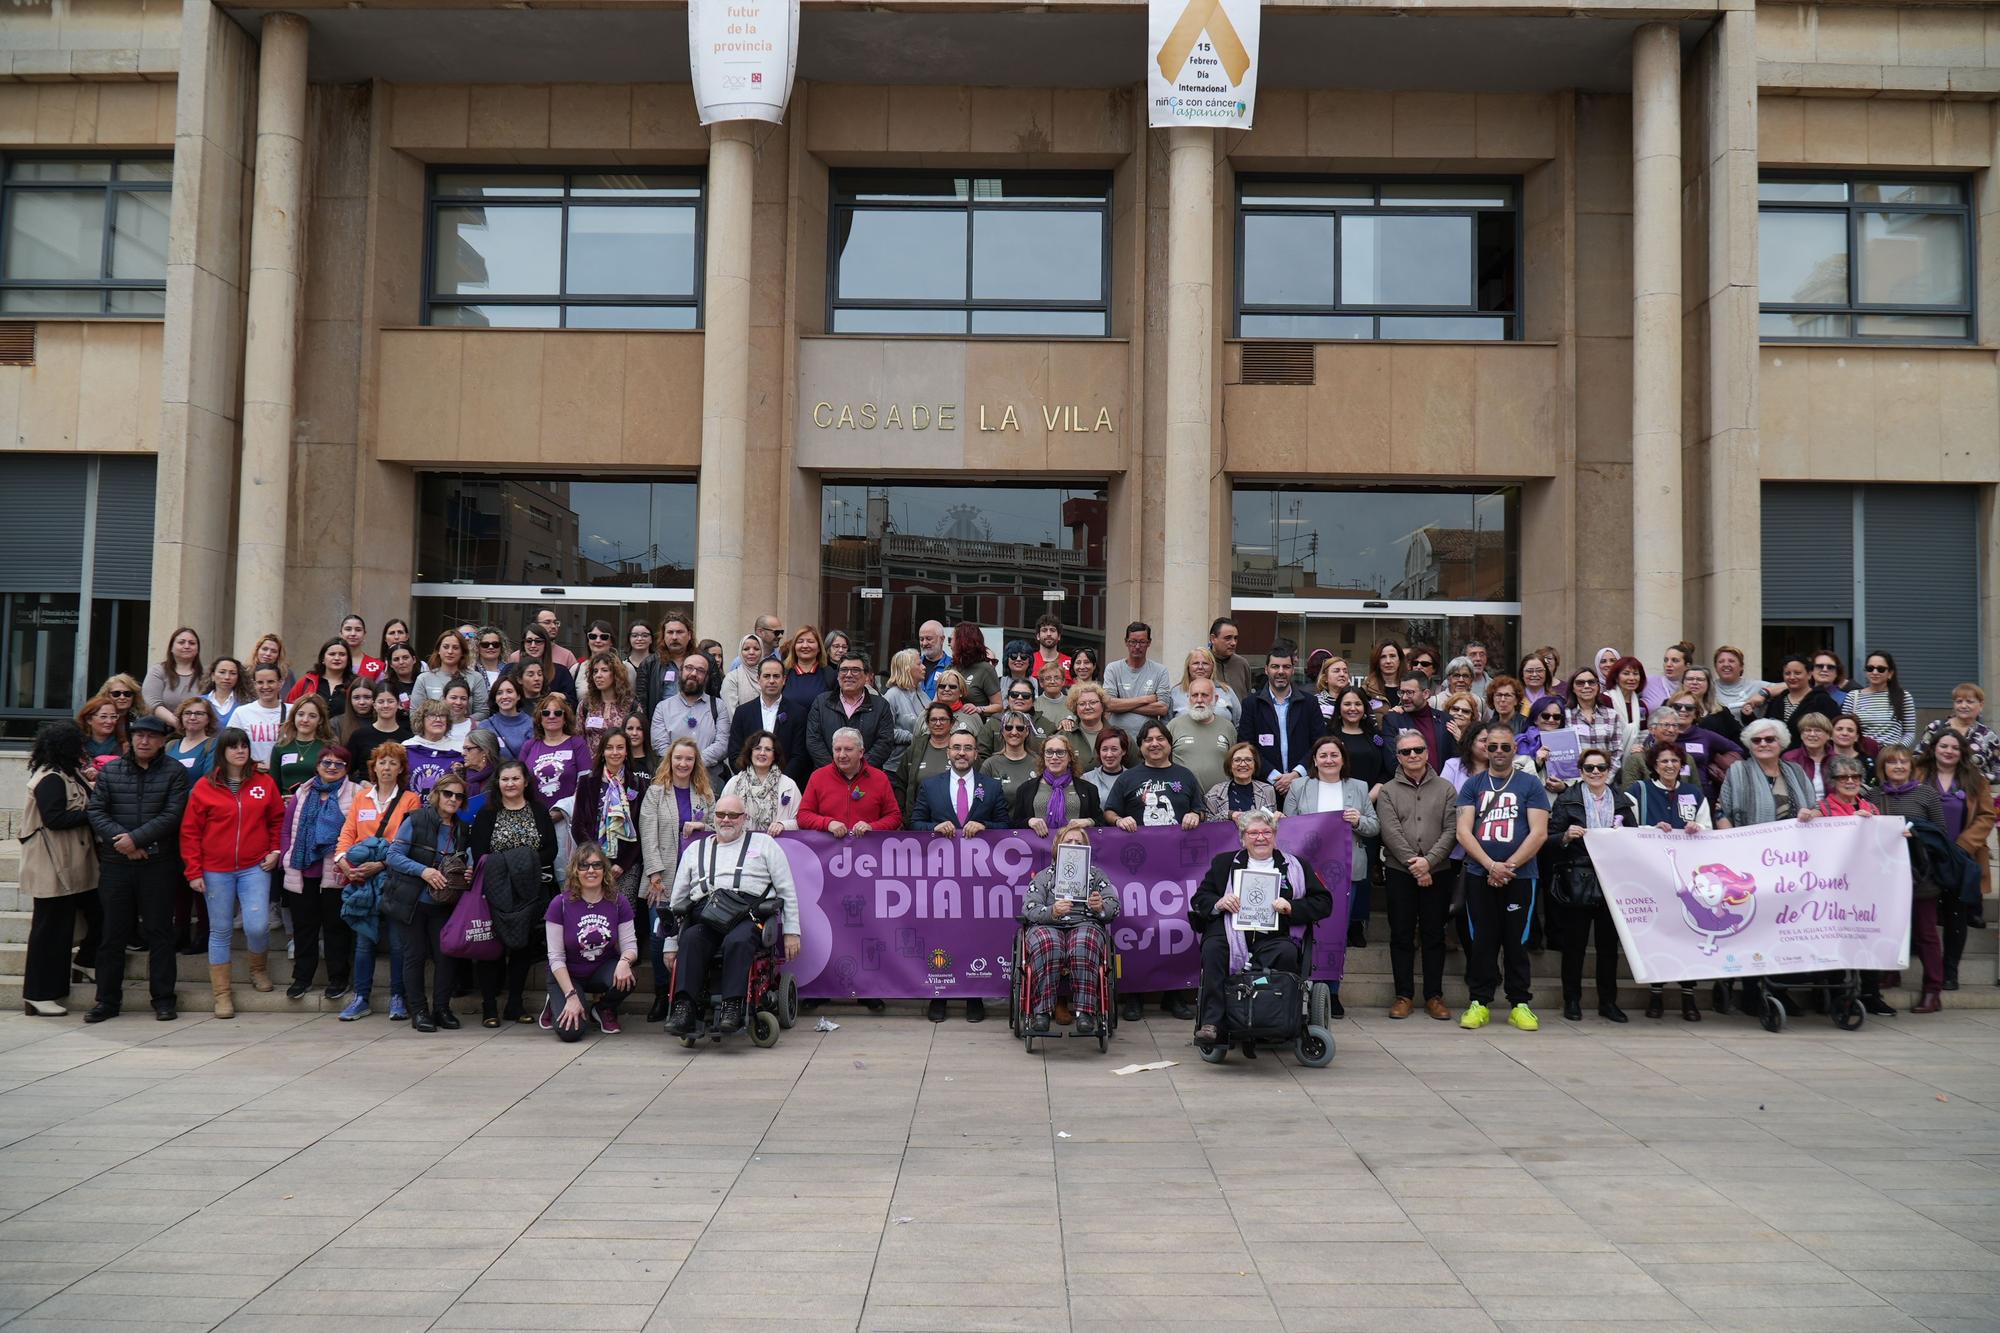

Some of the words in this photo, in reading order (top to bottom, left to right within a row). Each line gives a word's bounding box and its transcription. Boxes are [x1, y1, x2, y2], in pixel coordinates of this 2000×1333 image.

[727, 6, 760, 17] futur
[727, 23, 742, 34] de
[745, 23, 757, 34] la
[713, 40, 773, 54] provincia
[1197, 43, 1211, 52] 15
[1189, 56, 1218, 66] Febrero
[1197, 70, 1209, 79] Día
[1178, 83, 1228, 93] Internacional
[1186, 99, 1203, 107] con
[1205, 97, 1237, 107] cáncer
[1176, 107, 1236, 120] aspanion
[980, 404, 1021, 433] LA
[1042, 405, 1114, 433] VILA
[1142, 778, 1167, 793] Fight
[828, 847, 878, 879] de
[881, 836, 1034, 887] MARÇ
[1761, 847, 1810, 867] Grup
[1774, 876, 1796, 893] de
[1799, 871, 1850, 892] Dones
[875, 879, 962, 919] DIA
[1775, 904, 1799, 924] de
[1800, 900, 1876, 922] Vila-real
[471, 919, 482, 928] TU
